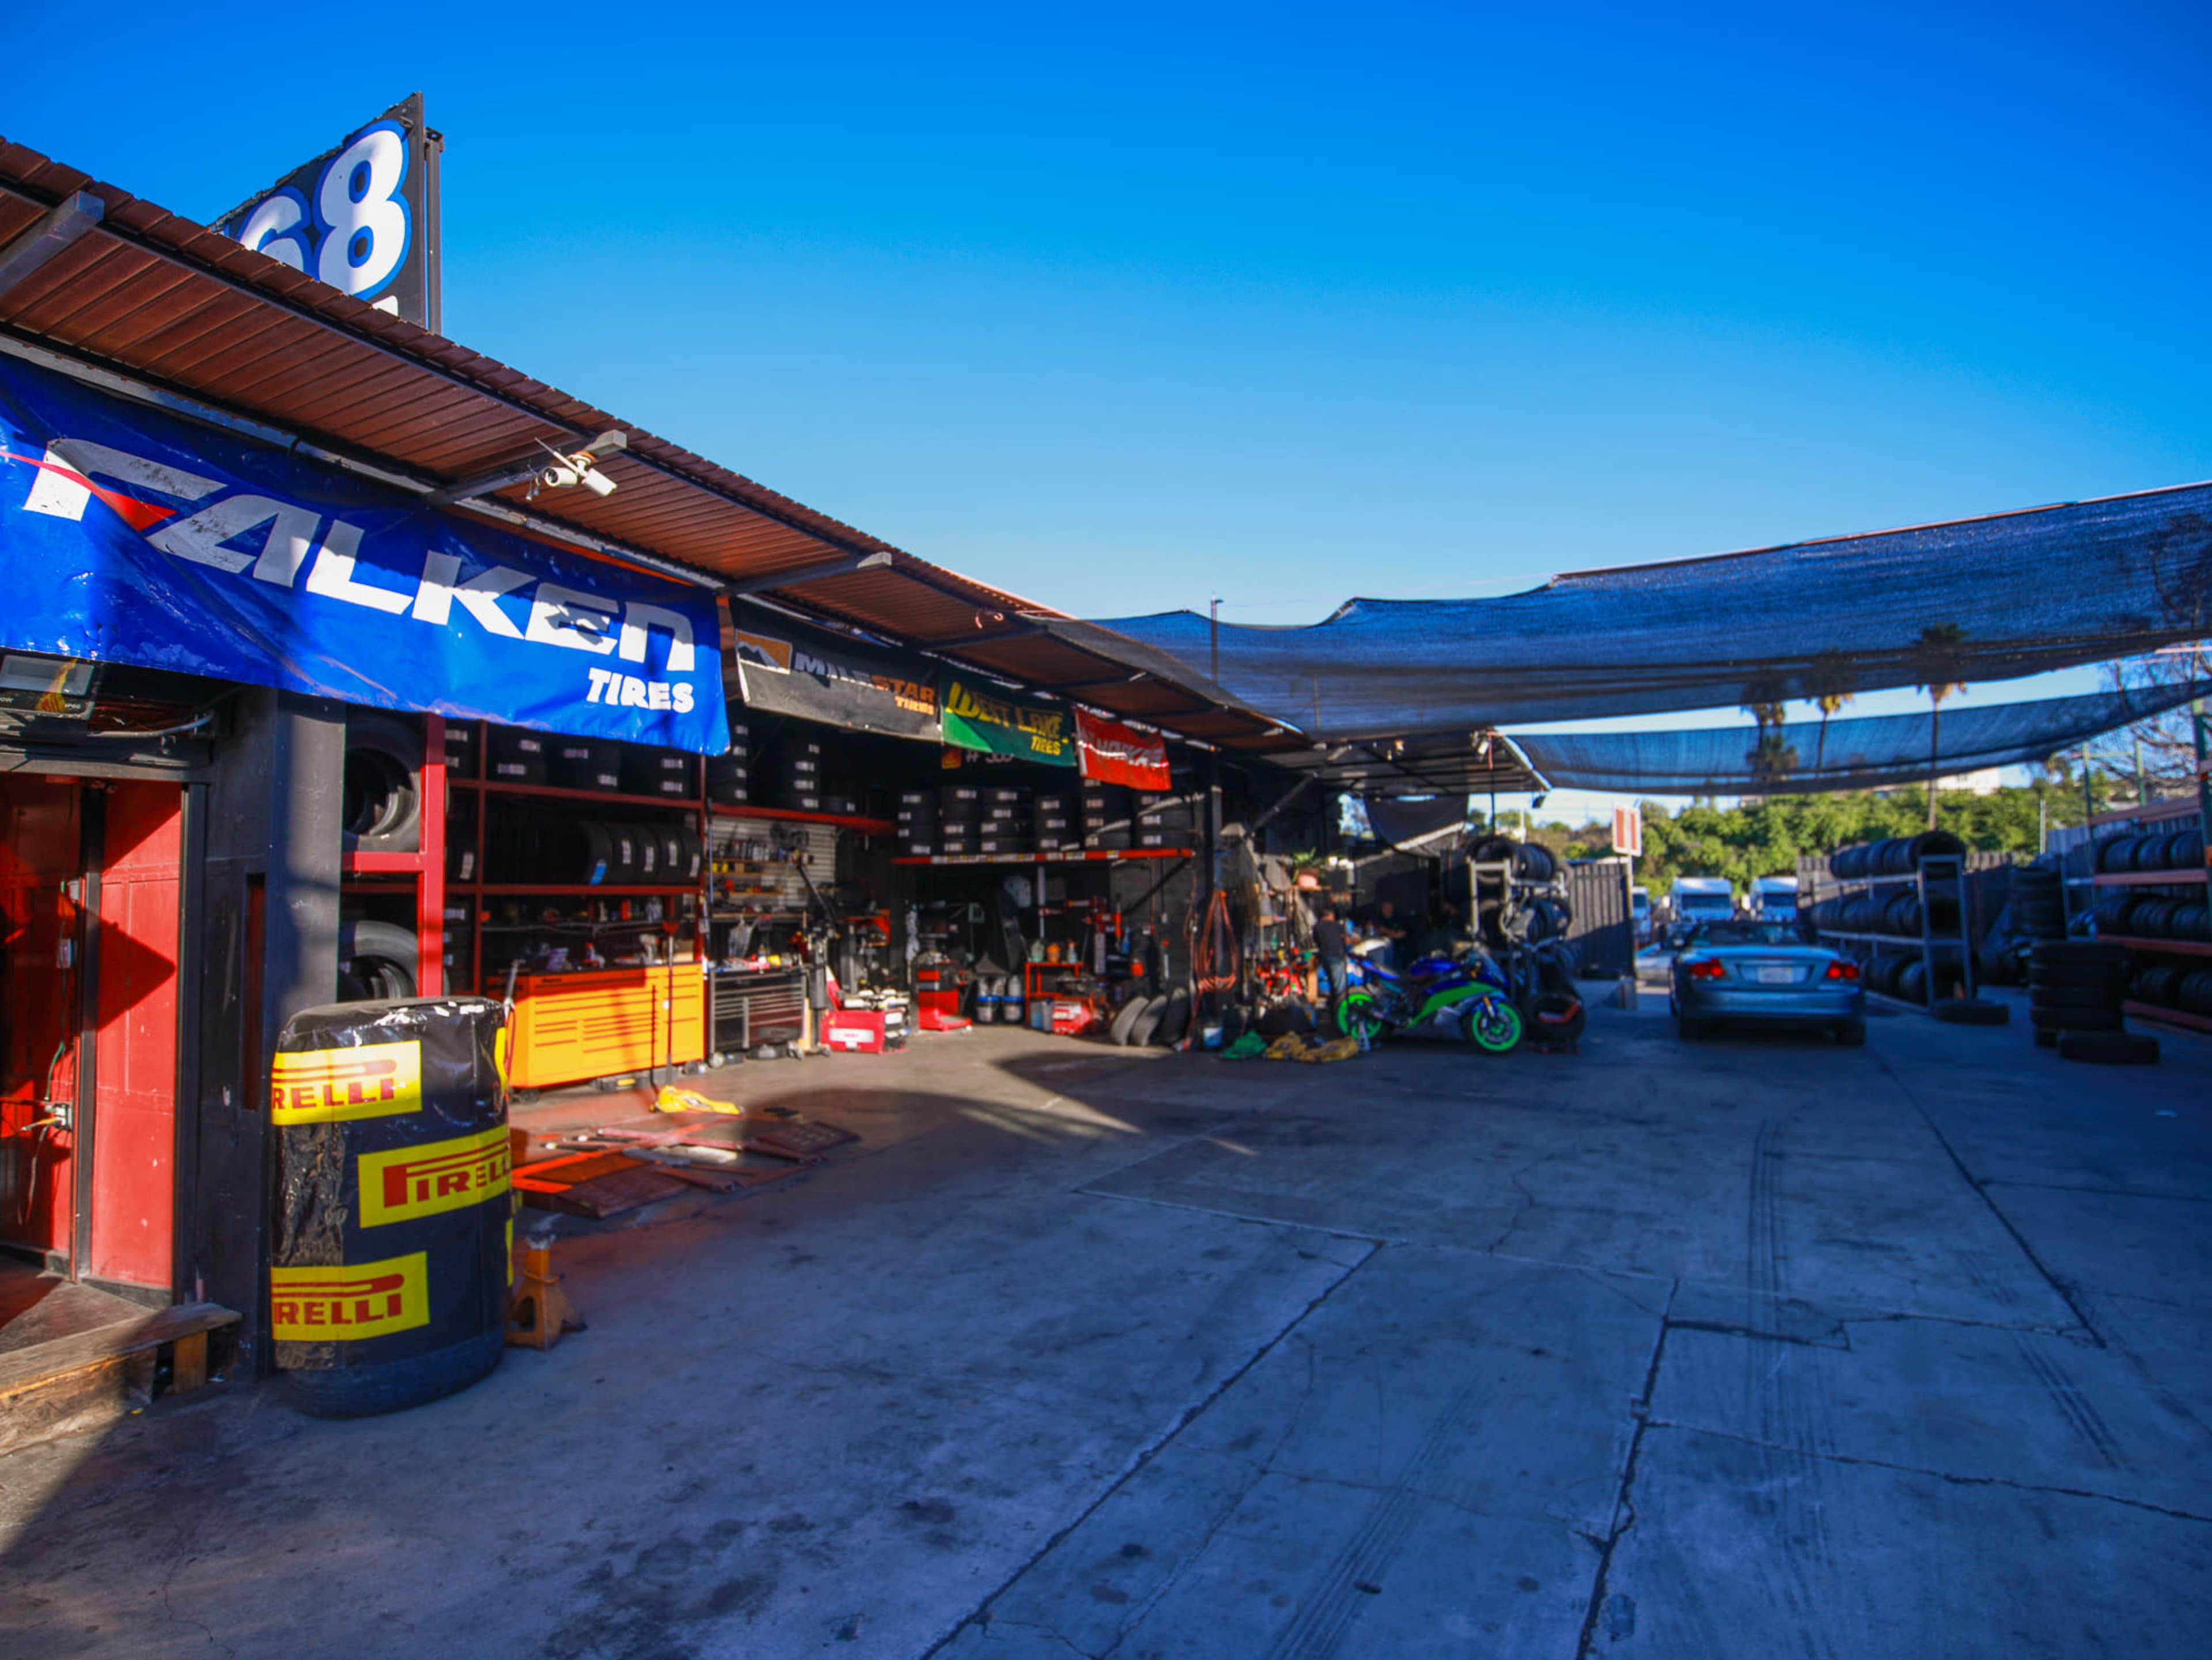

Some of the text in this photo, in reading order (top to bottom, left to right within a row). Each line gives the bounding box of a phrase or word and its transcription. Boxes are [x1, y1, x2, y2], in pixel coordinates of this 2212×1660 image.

[23, 438, 695, 672] FALKEN
[587, 668, 695, 714] TIRES
[894, 695, 935, 716] TIRES
[1031, 735, 1061, 756] TIRES
